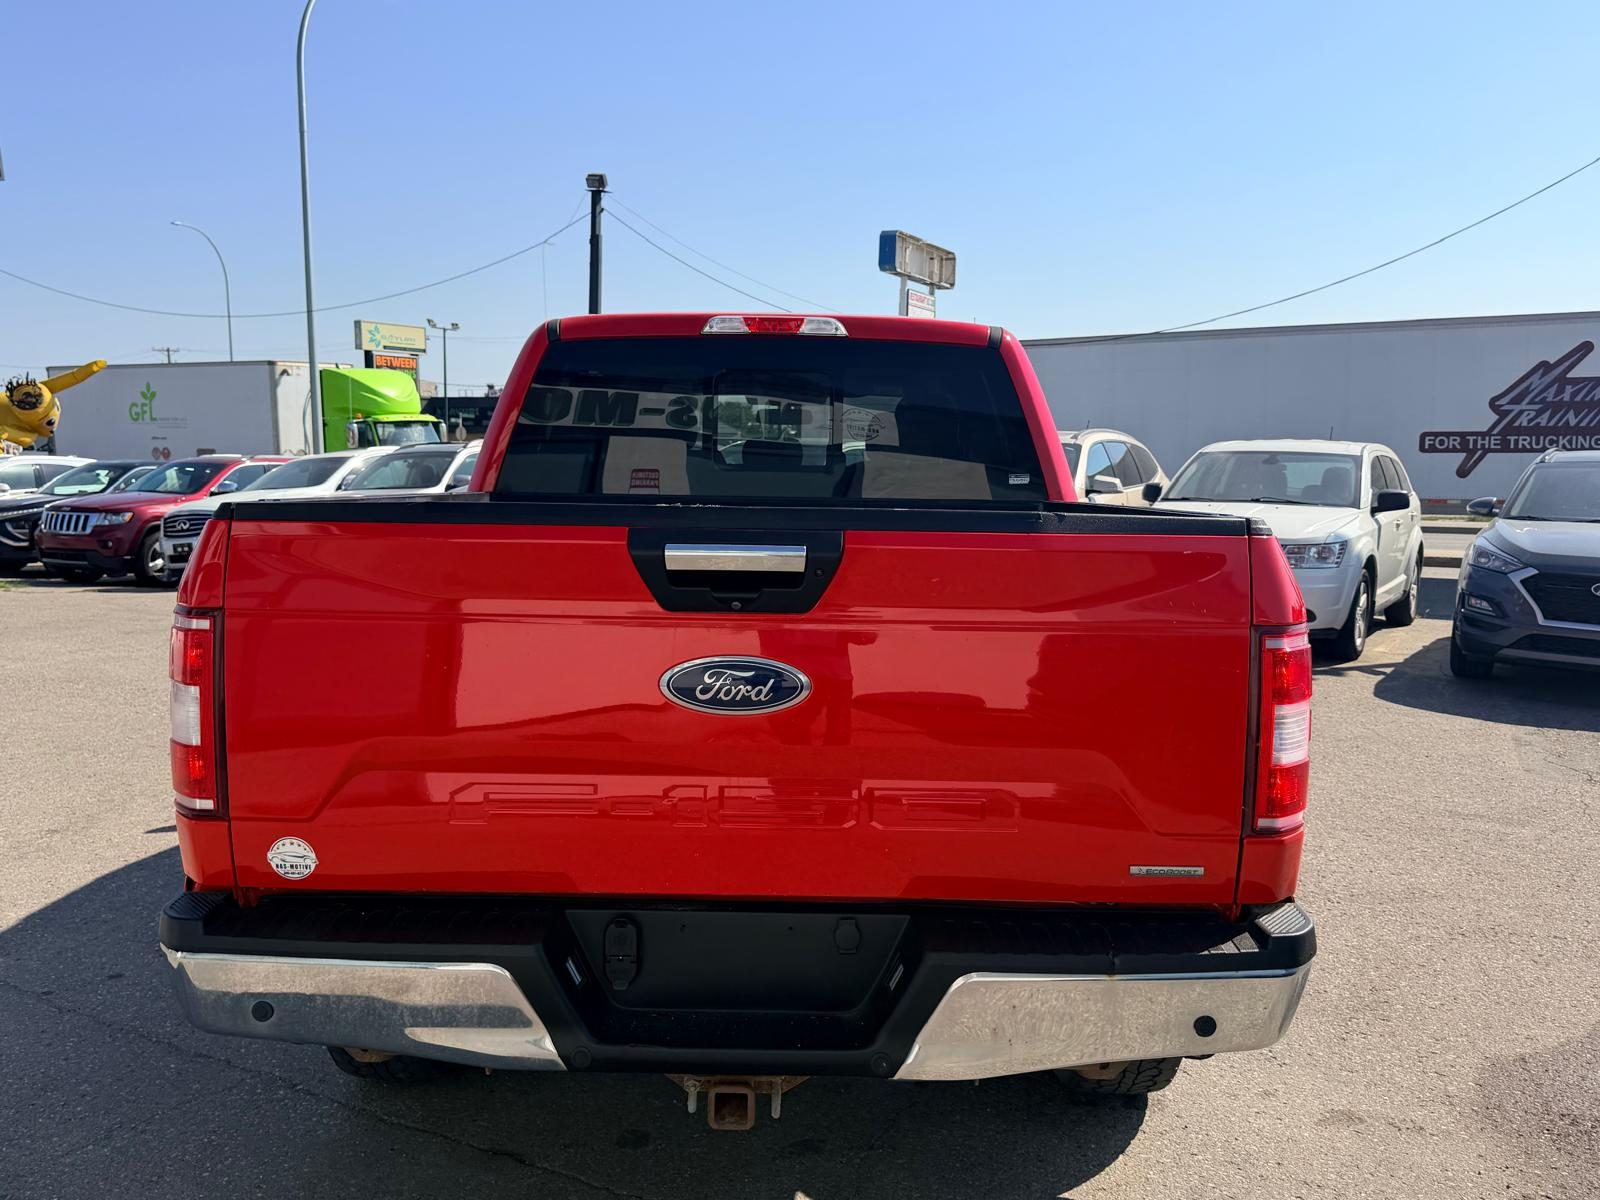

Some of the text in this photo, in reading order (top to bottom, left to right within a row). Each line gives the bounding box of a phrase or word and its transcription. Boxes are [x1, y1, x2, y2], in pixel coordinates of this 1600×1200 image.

[375, 355, 417, 369] BETWEEN
[128, 400, 158, 422] GFL
[1424, 435, 1600, 449] FOR THE TRUCKING
[695, 668, 775, 701] Ford
